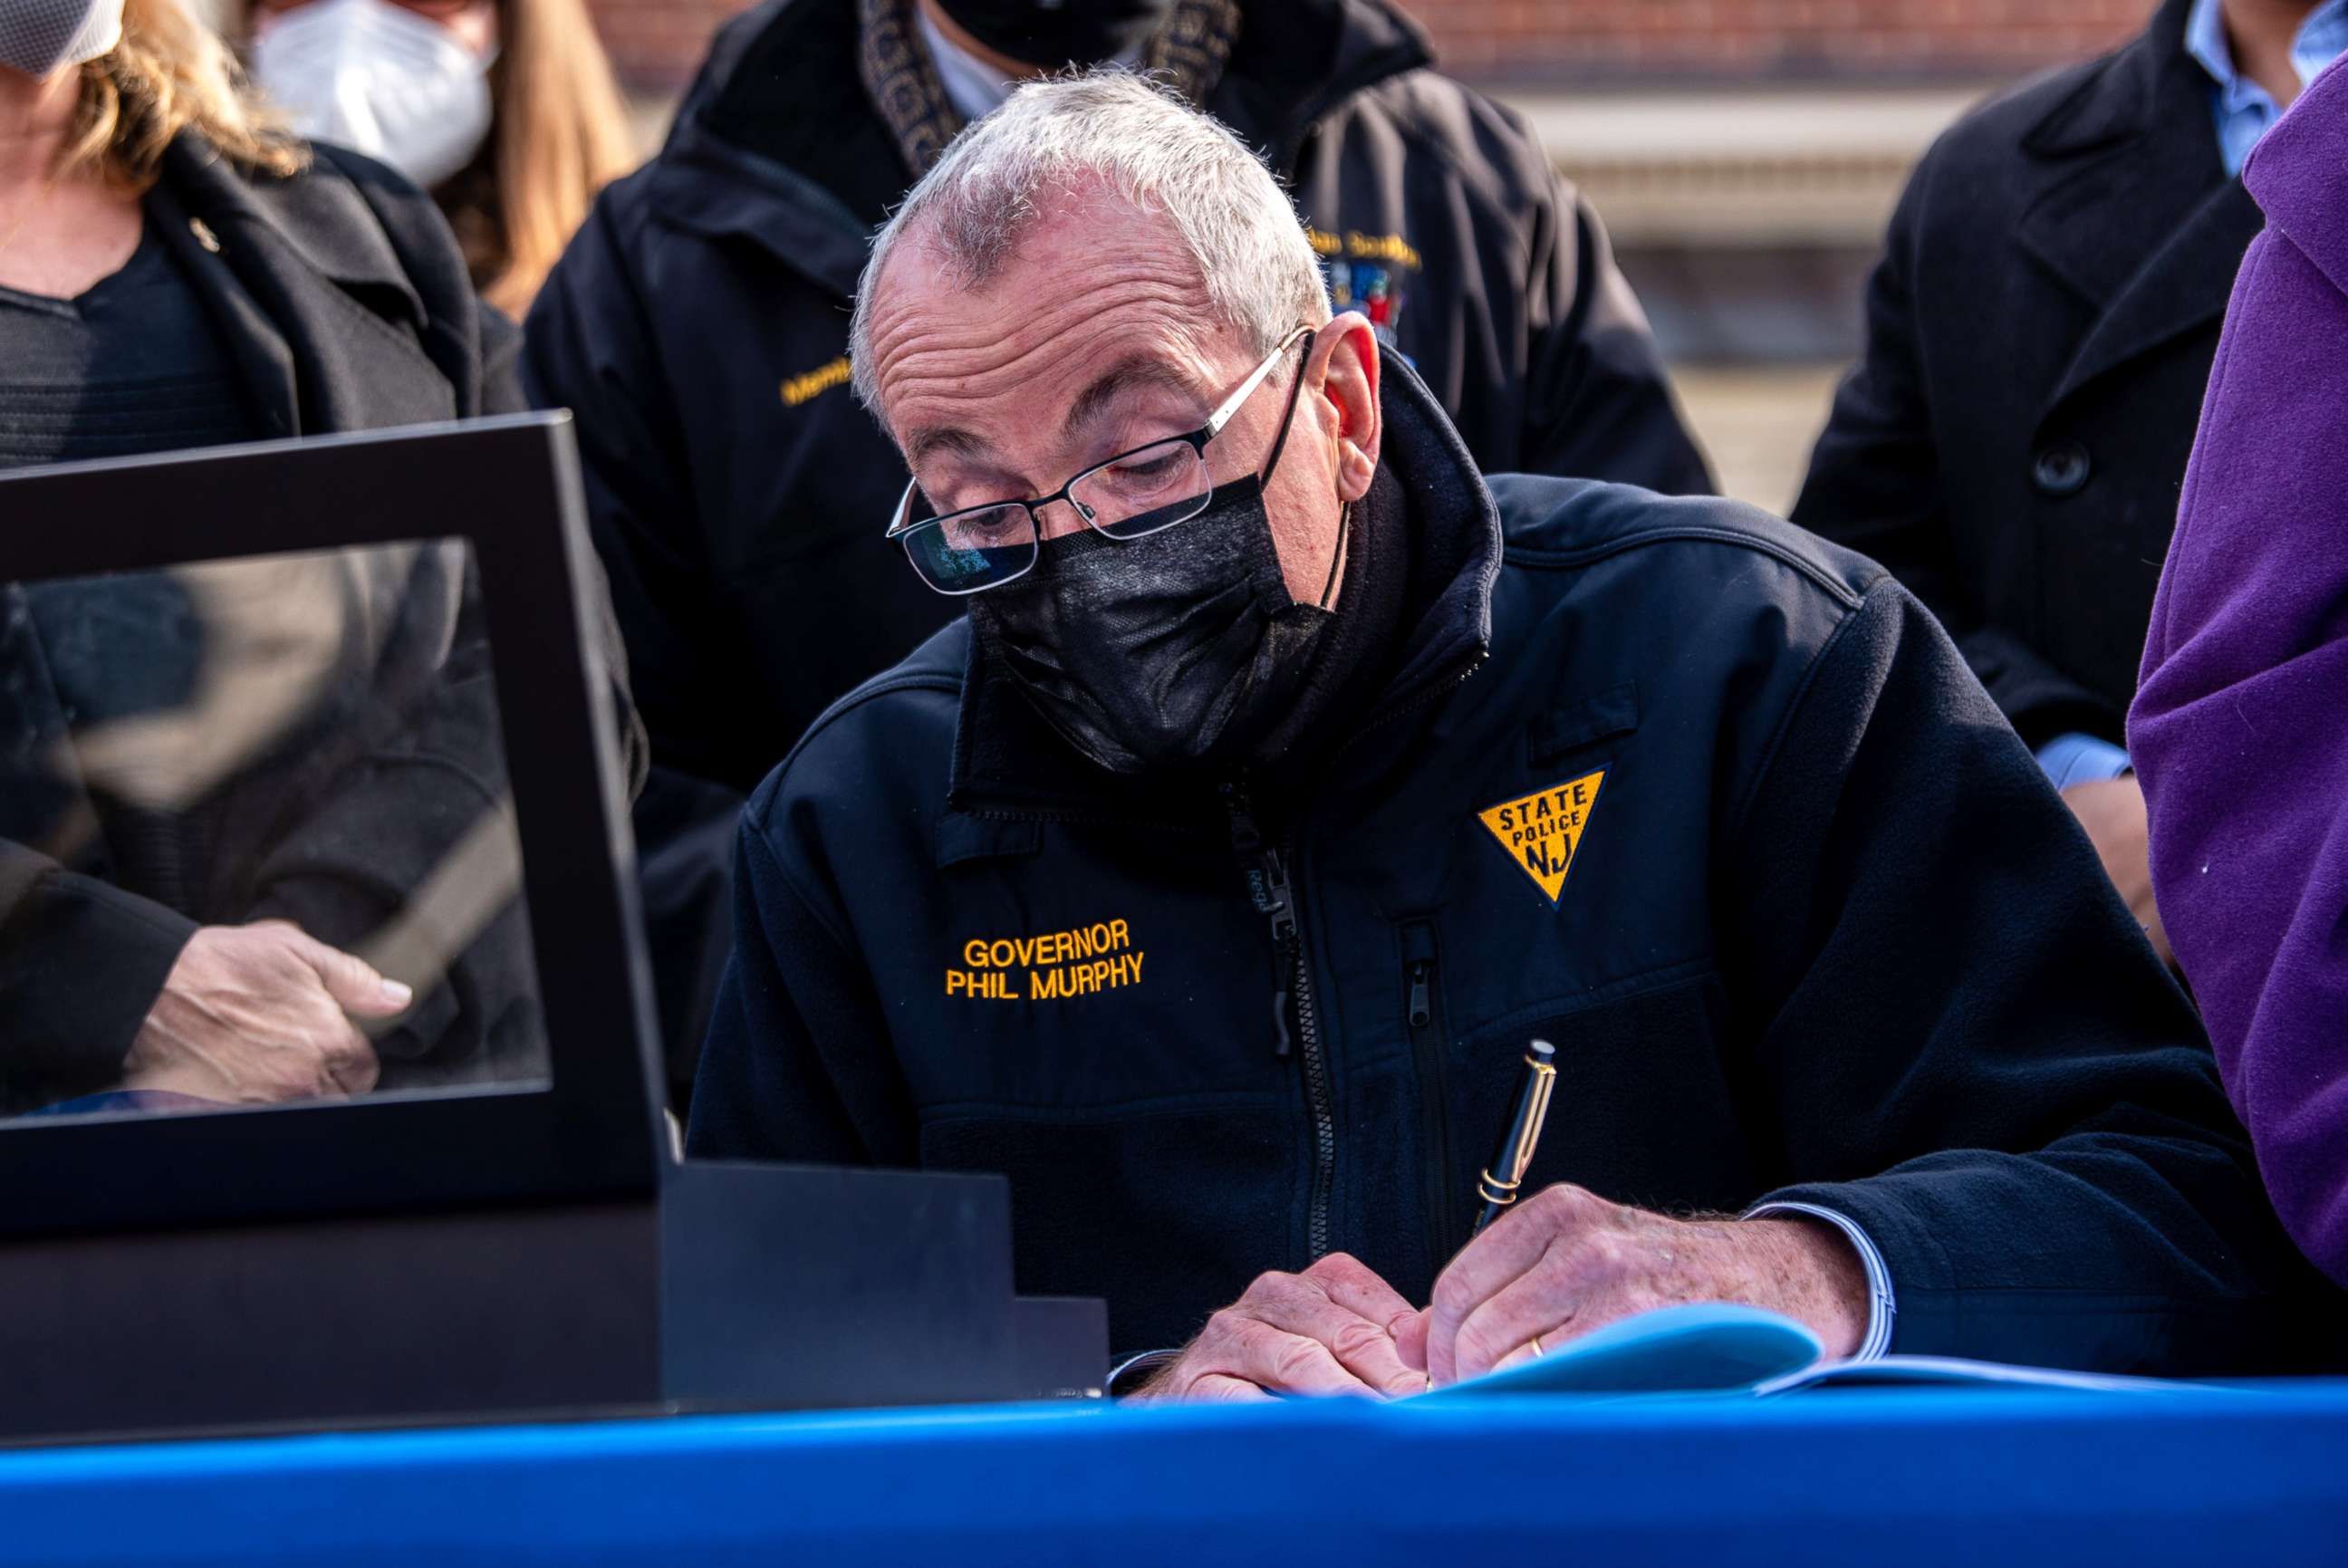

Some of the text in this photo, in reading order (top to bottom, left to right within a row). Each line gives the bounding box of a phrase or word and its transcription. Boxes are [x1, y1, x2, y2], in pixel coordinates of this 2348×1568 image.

[1499, 784, 1587, 831] STATE
[1513, 811, 1581, 847] POLICE
[1525, 833, 1572, 878] NJ
[965, 919, 1130, 967] GOVERNOR
[947, 952, 1143, 1000] PHIL MURPHY
